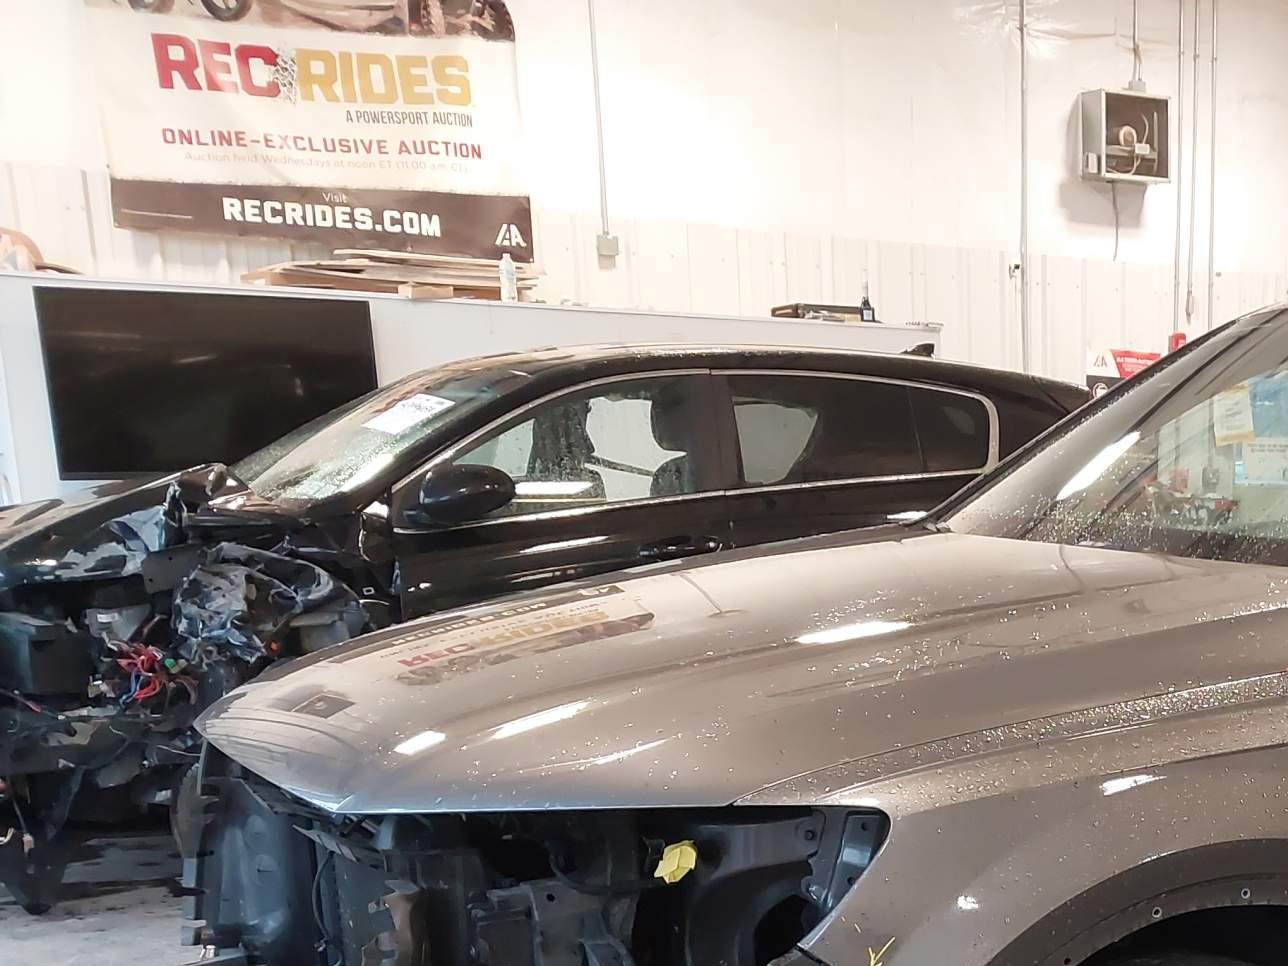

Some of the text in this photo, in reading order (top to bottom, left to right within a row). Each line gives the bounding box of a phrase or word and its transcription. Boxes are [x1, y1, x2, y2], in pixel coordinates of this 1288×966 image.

[150, 32, 472, 106] REC RIDES
[345, 110, 473, 128] A POWERSPORT AUCTION
[161, 128, 482, 160] ONLINE-EXCLUSIVE AUCTION
[322, 191, 348, 203] Visit
[222, 196, 441, 238] RECRIDES.COM
